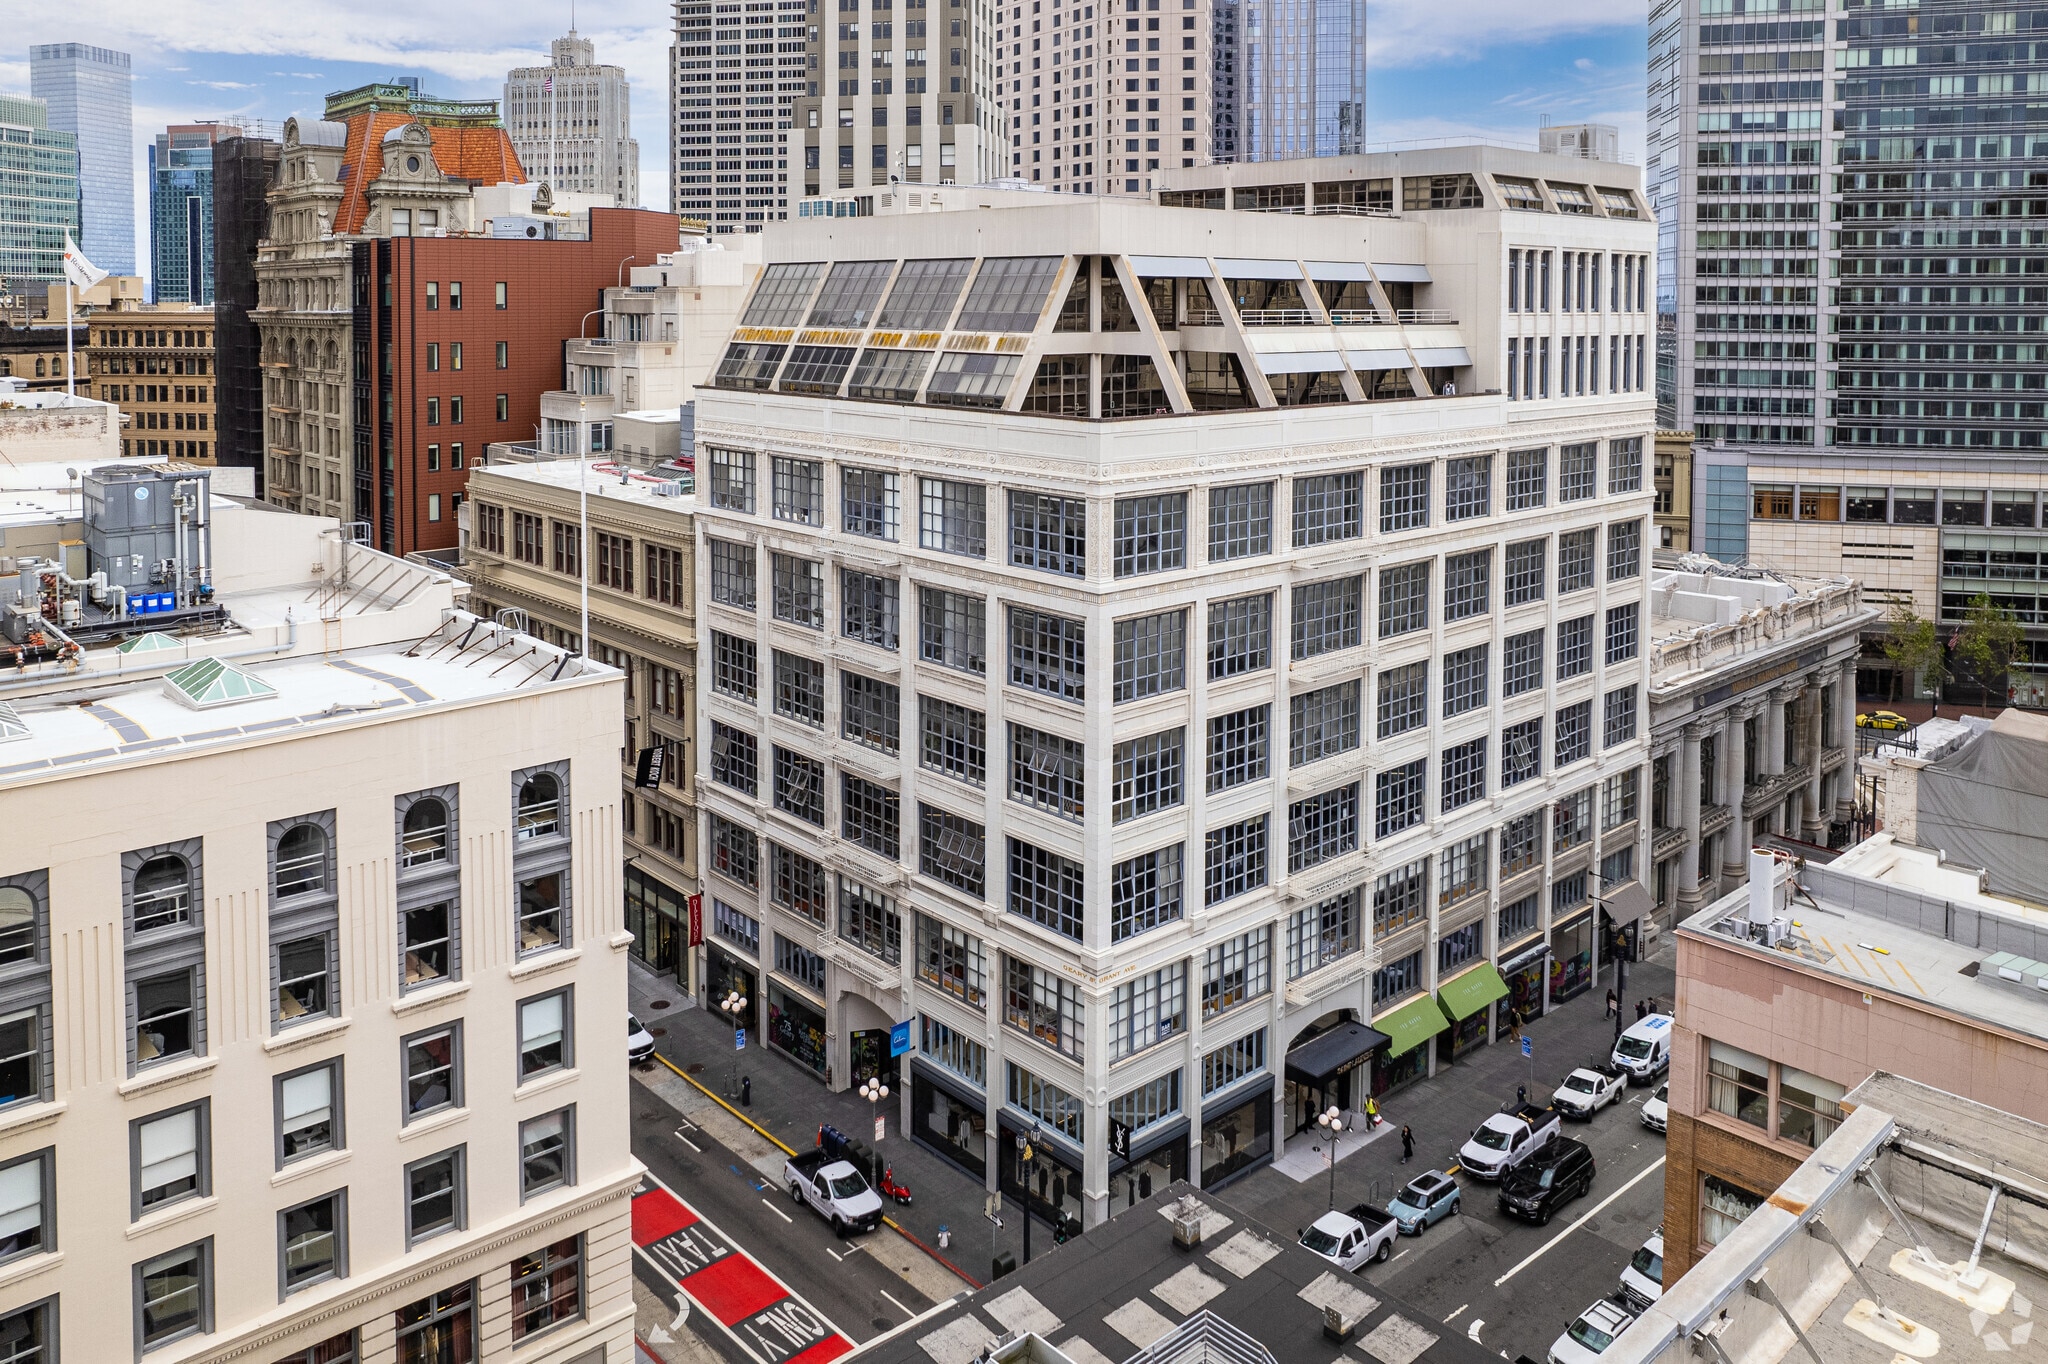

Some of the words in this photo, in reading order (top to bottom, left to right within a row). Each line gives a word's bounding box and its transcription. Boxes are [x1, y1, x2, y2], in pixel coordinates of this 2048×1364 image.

[0, 294, 25, 309] CE
[650, 747, 663, 766] ROBERT
[1063, 964, 1088, 979] GEARY
[1099, 971, 1121, 984] GRANT
[652, 1226, 728, 1276] TAXI
[743, 1301, 825, 1362] ONLY
